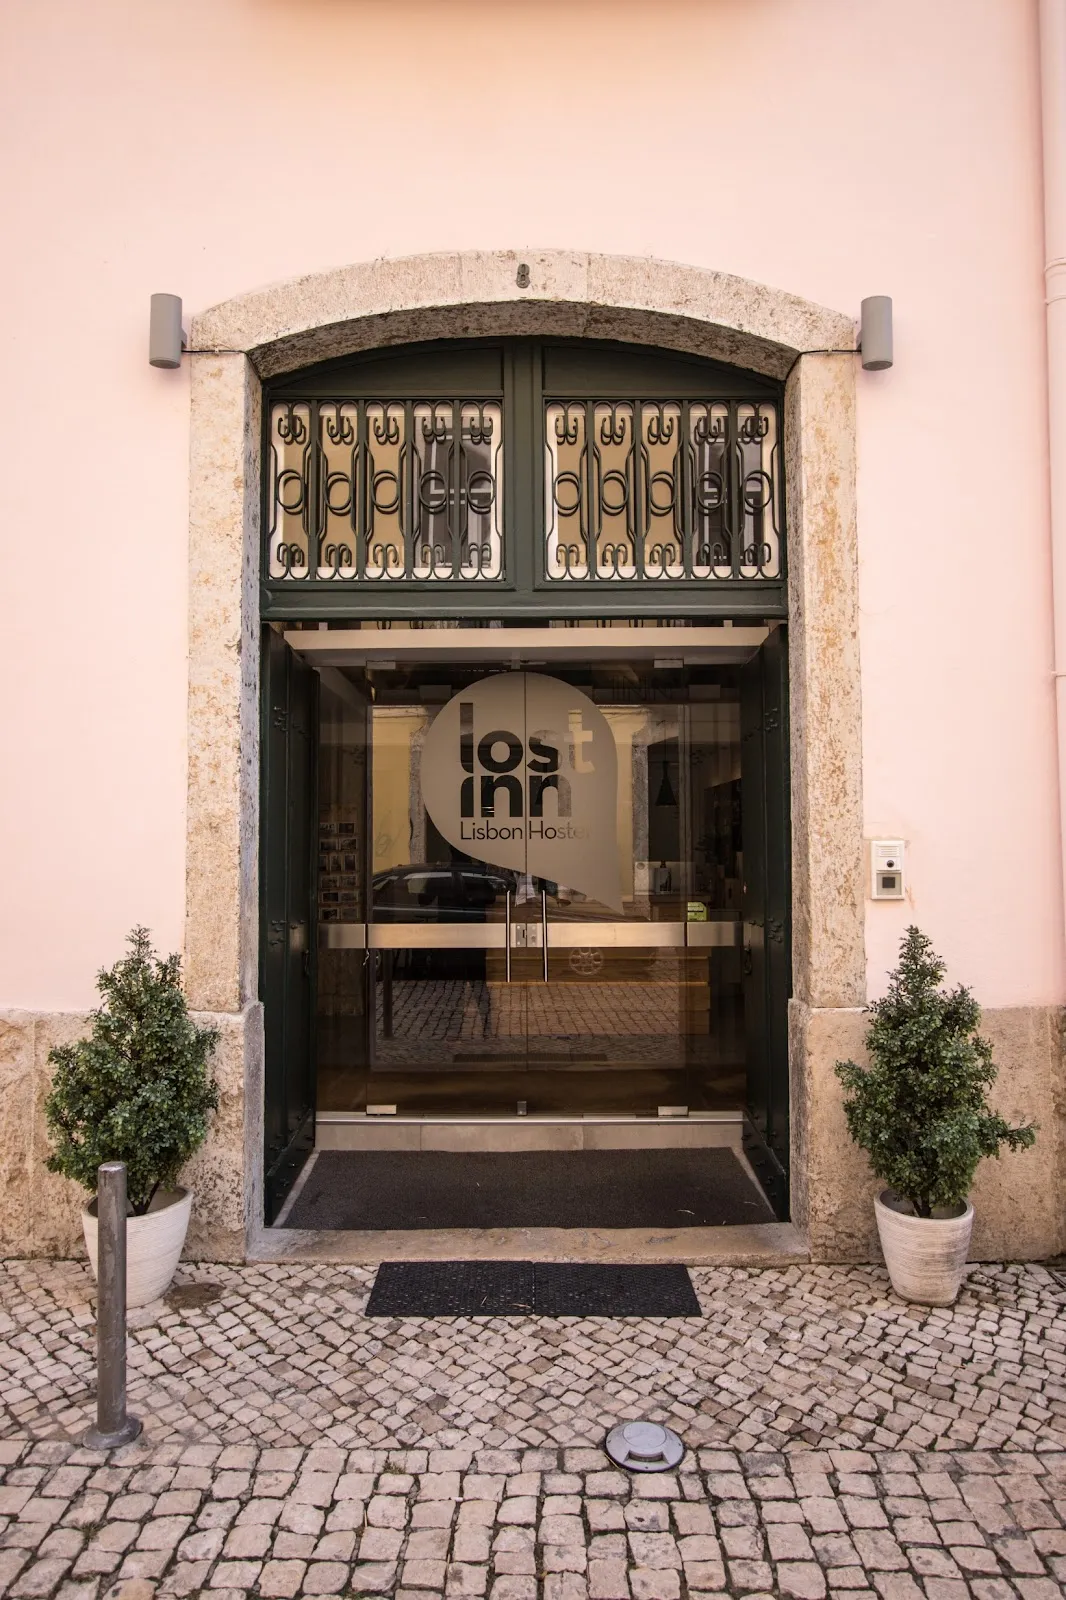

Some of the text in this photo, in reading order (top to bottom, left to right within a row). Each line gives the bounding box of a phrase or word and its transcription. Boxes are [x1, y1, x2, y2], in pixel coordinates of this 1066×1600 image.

[460, 702, 595, 774] lost
[460, 774, 572, 818] inn
[460, 820, 523, 841] Lisbon
